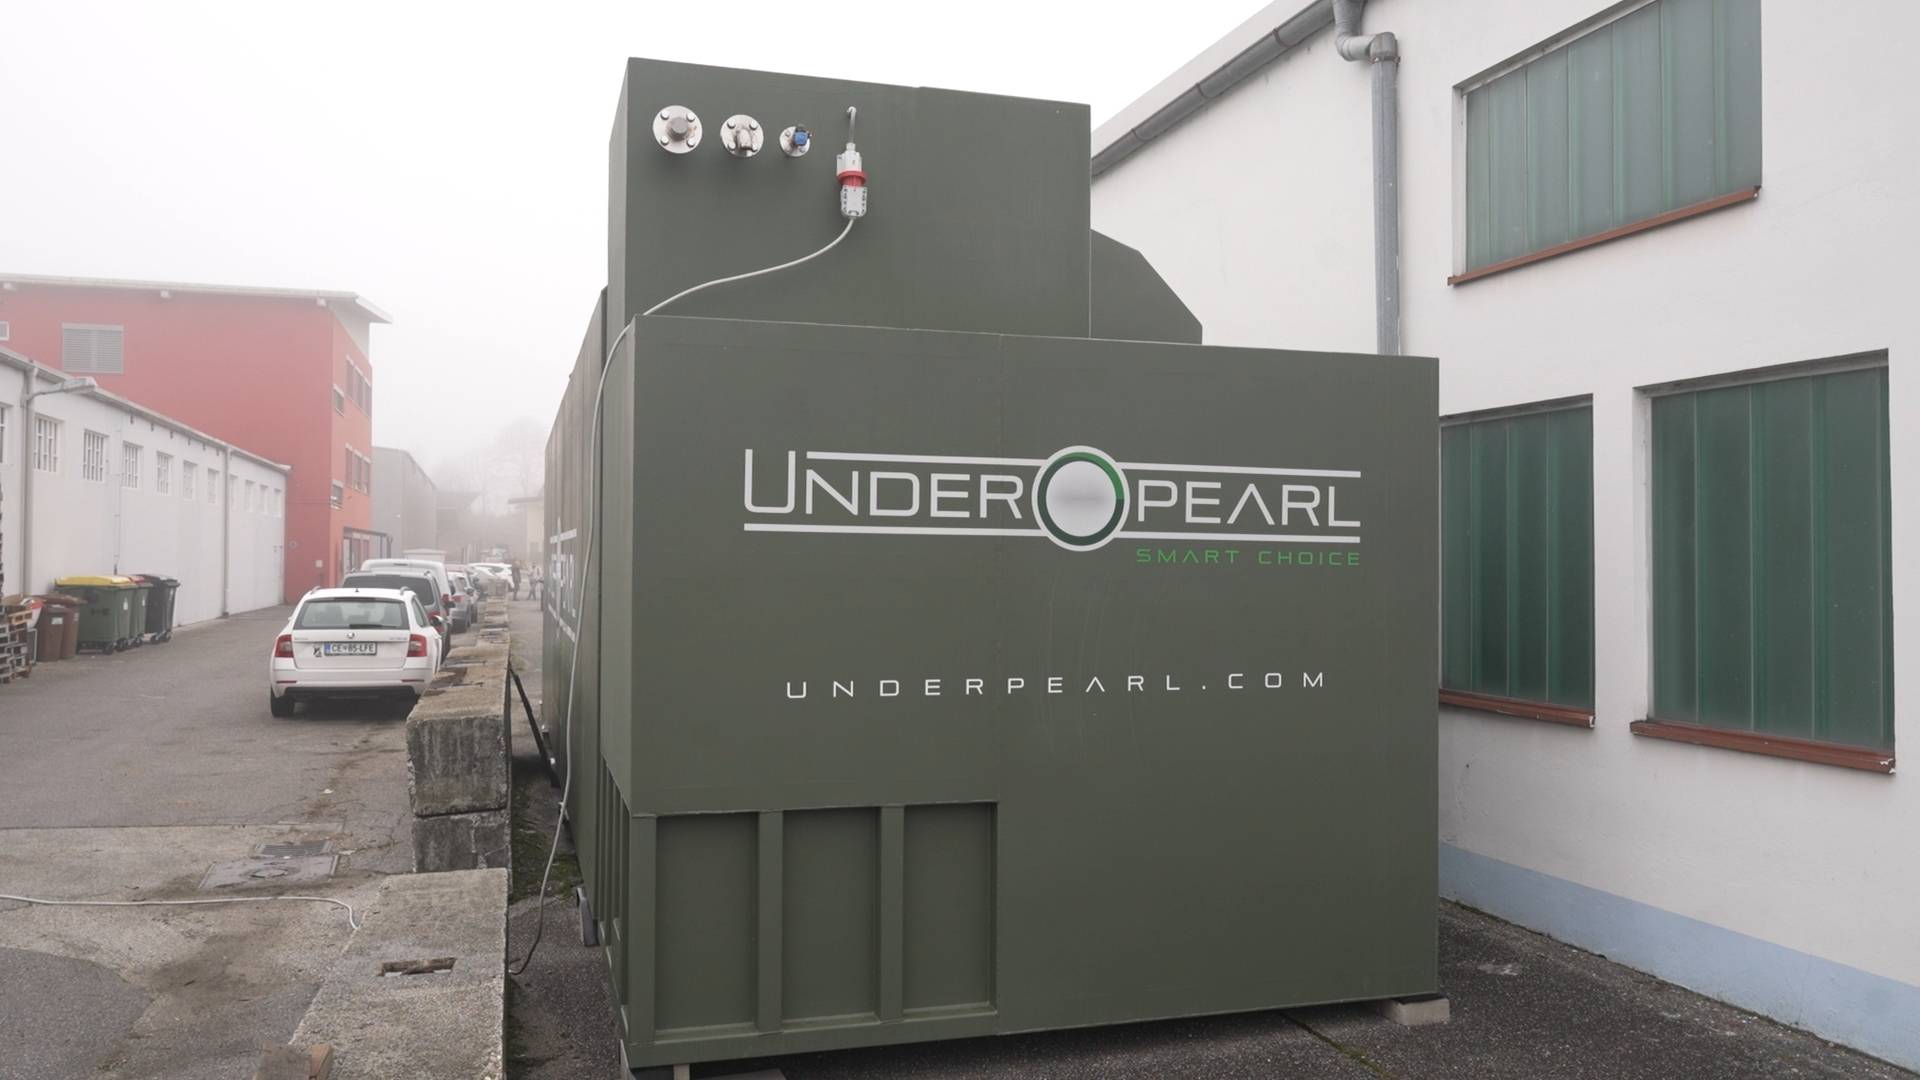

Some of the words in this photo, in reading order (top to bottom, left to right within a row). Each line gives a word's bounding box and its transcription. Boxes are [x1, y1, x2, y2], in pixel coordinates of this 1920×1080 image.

[1136, 548, 1240, 564] SMART
[1257, 551, 1361, 566] CHOICE
[786, 671, 1324, 699] UNDERPEARL.COM
